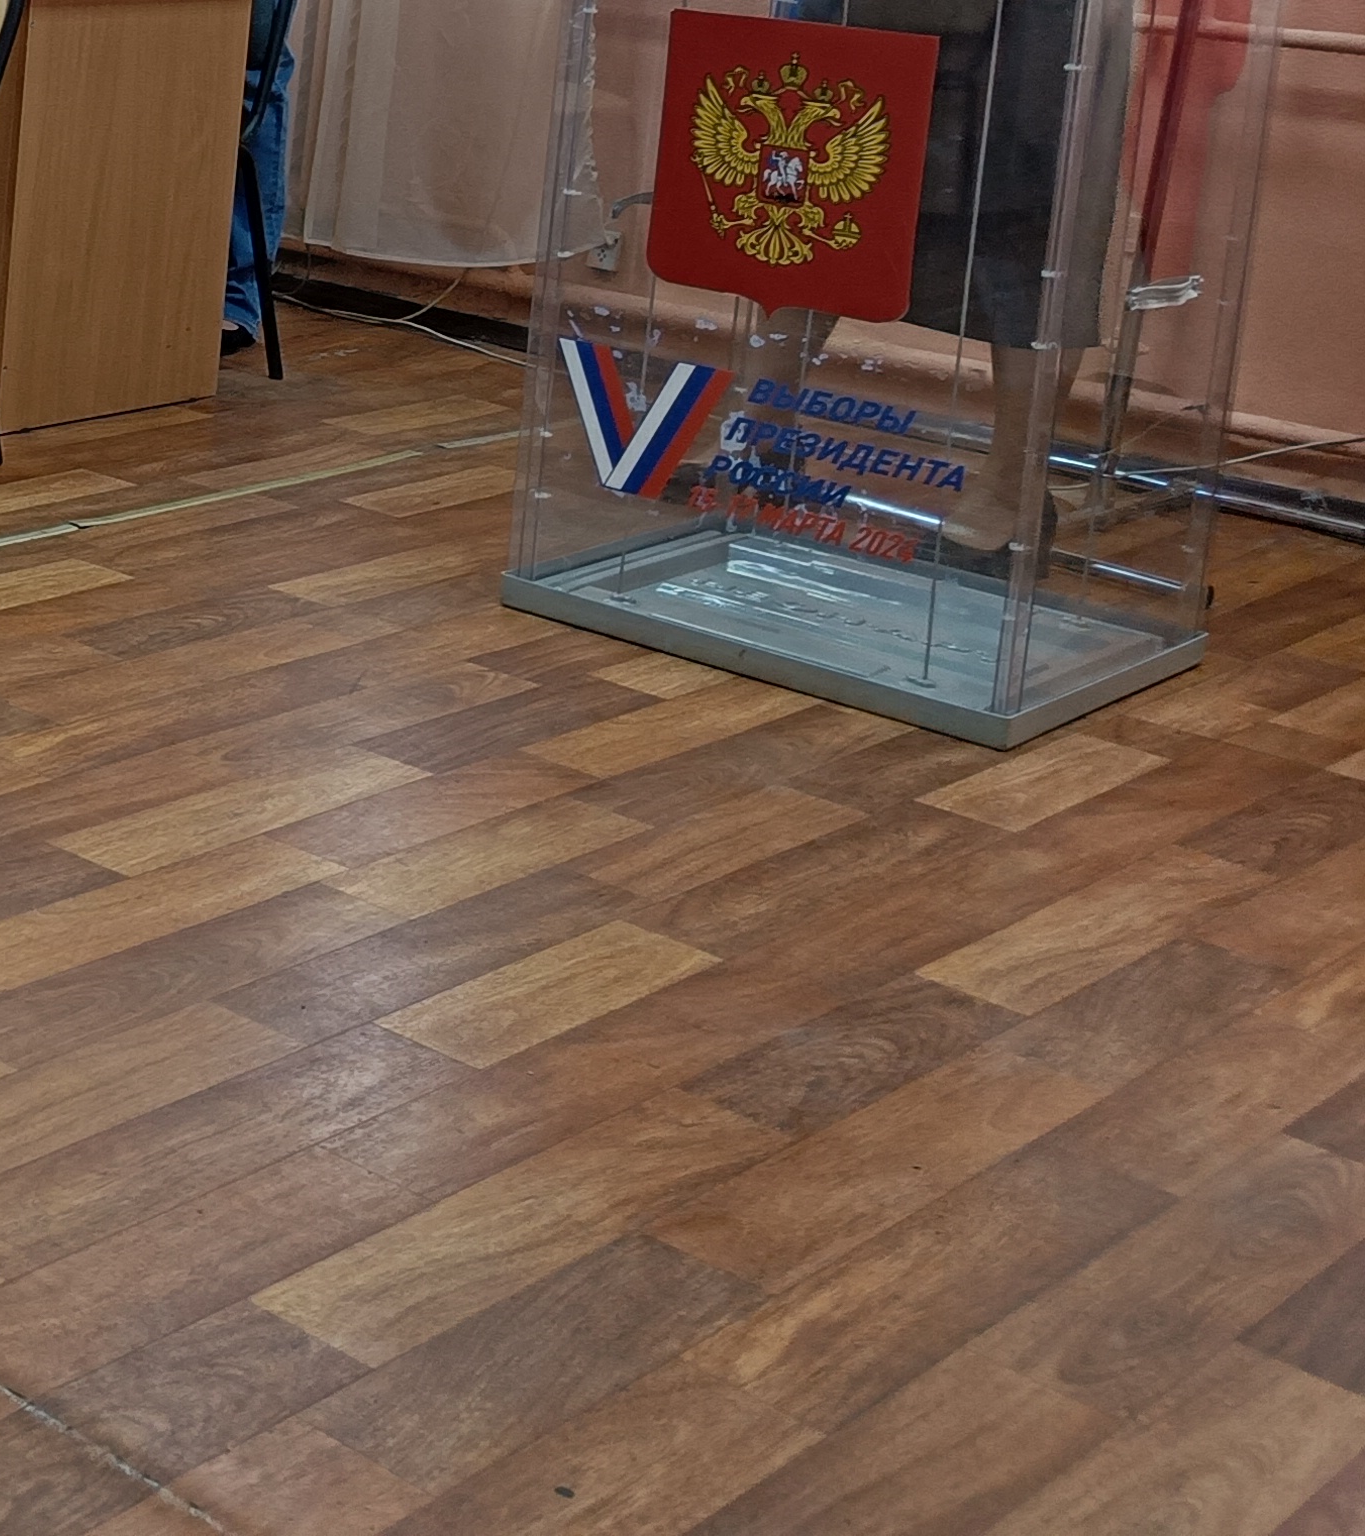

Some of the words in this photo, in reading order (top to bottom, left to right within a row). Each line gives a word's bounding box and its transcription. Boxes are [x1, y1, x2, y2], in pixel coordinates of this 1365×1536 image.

[747, 377, 917, 436] ВЫБОРЫ
[703, 454, 852, 509] РОССИИ
[723, 416, 968, 493] ПРЕЗИДЕНТА
[756, 502, 848, 546] МАРТА
[848, 526, 920, 564] 2024
